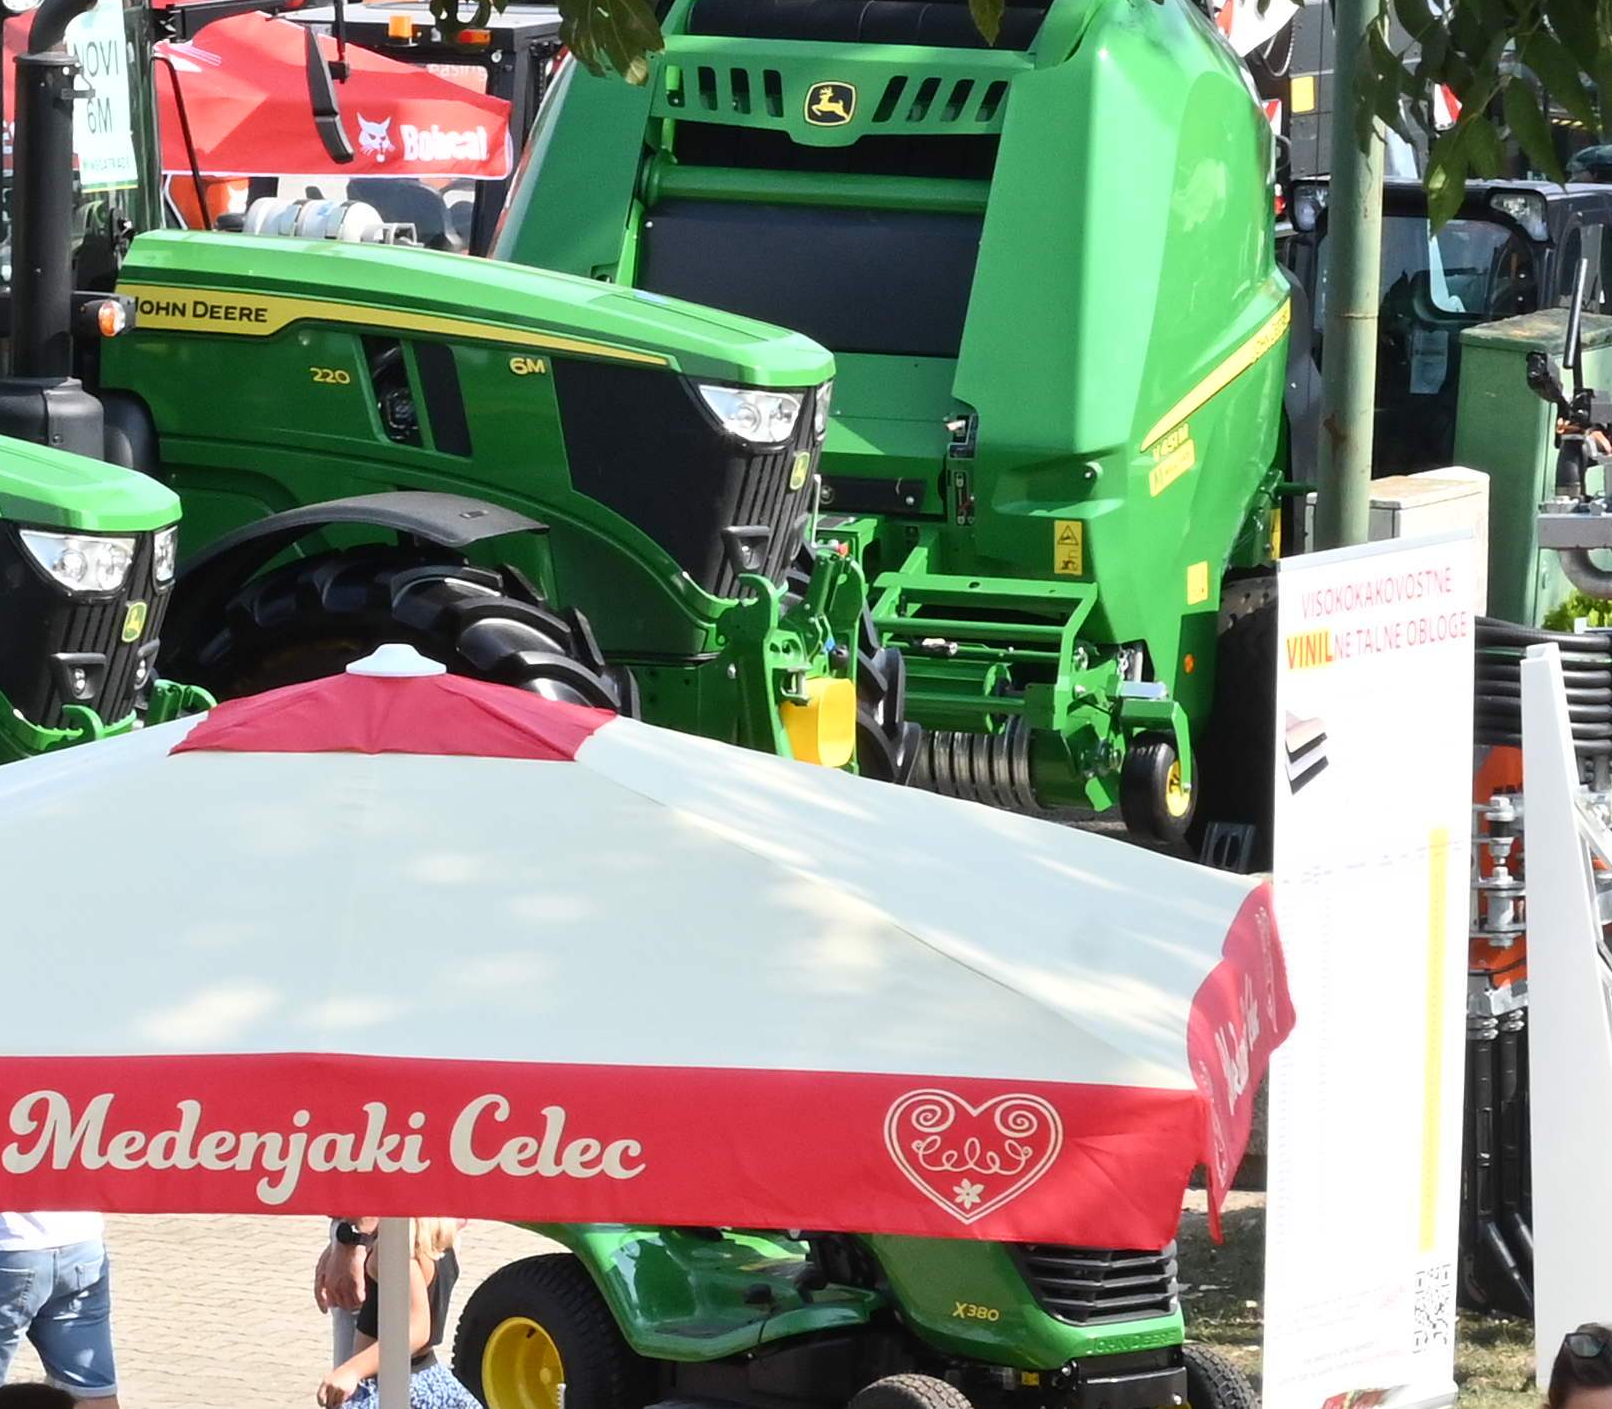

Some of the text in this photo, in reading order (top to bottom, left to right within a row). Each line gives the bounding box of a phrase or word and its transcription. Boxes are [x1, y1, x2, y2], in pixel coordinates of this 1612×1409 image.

[86, 97, 113, 134] 6M
[399, 123, 490, 162] Bobcat
[134, 295, 268, 324] JOHN DEERE
[309, 366, 351, 386] 220
[508, 356, 546, 376] 6M
[1286, 610, 1468, 671] VINILNE TALNE OBLOGE
[1, 1089, 646, 1206] Medenjaki Celec
[951, 1302, 1000, 1323] X380
